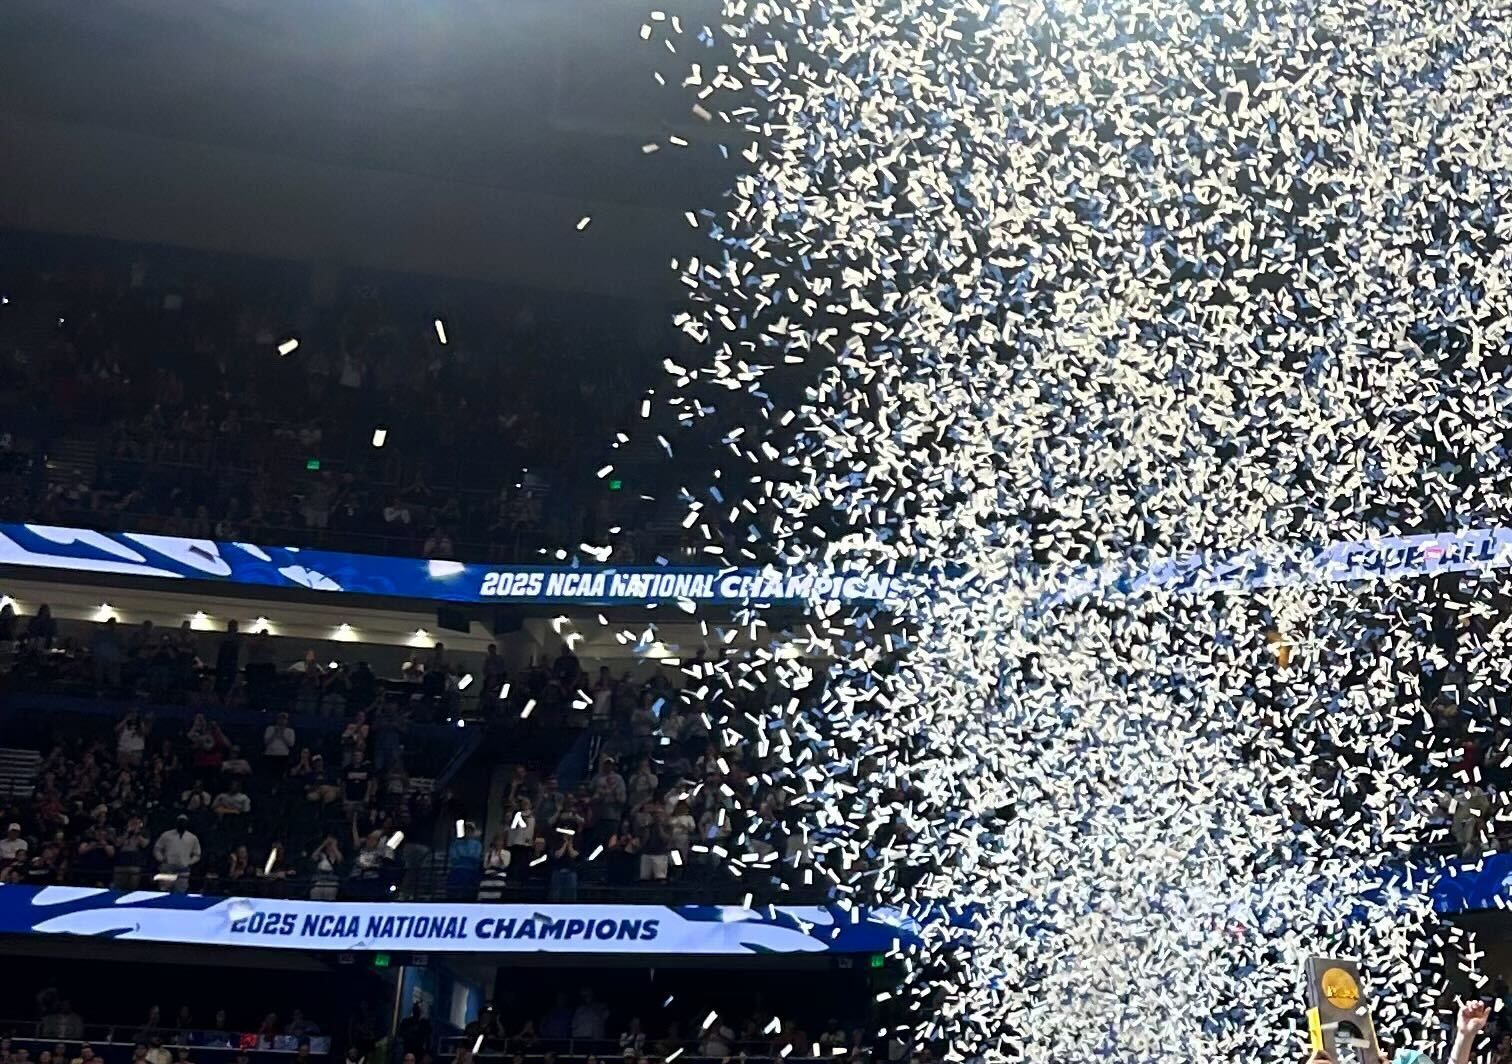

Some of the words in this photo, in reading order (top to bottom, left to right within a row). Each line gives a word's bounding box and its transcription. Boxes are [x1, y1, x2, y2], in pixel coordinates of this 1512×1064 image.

[480, 572, 543, 597] 2025
[546, 572, 603, 597] NCAA
[611, 572, 715, 598] NATIONAL
[301, 914, 360, 938] NCAA
[366, 916, 467, 939] NATIONAL
[475, 918, 658, 941] CHAMPIONS
